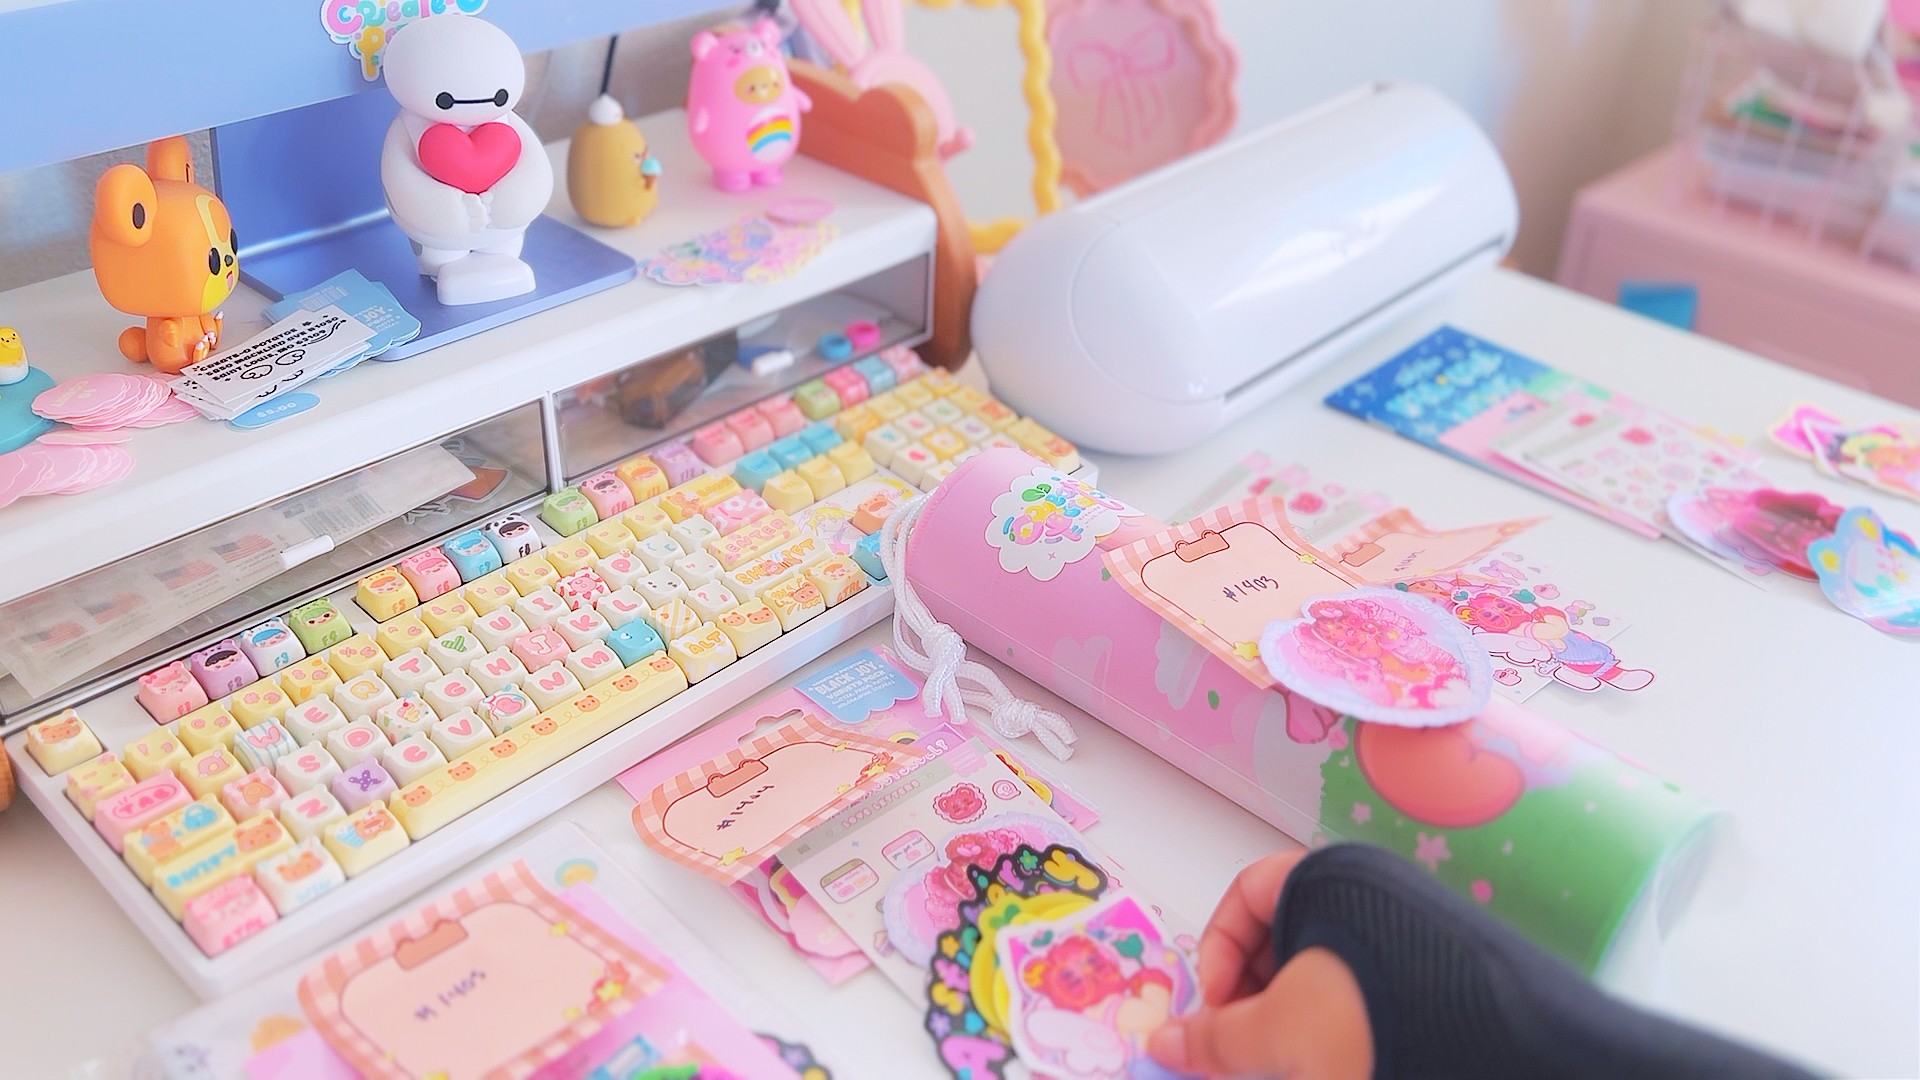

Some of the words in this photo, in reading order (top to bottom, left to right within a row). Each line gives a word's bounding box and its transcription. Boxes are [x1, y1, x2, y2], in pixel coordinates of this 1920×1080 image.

[576, 516, 588, 531] F9
[726, 518, 787, 553] ENTER
[1222, 575, 1279, 603] #1403
[613, 599, 637, 612] L
[489, 615, 512, 631] U
[569, 614, 599, 632] K
[529, 633, 553, 654] J
[688, 629, 722, 655] ALT
[275, 652, 289, 668] F3
[399, 657, 421, 674] T
[486, 658, 512, 675] H
[580, 650, 610, 669] M
[227, 676, 243, 692] F2
[539, 671, 566, 691] N
[814, 672, 855, 695] BLACK
[854, 661, 879, 677] JOY
[443, 681, 467, 697] G
[304, 706, 329, 724] E
[448, 718, 473, 737] V
[247, 726, 281, 749] W
[403, 745, 428, 763] C
[297, 755, 321, 773] S
[297, 799, 328, 818] Z
